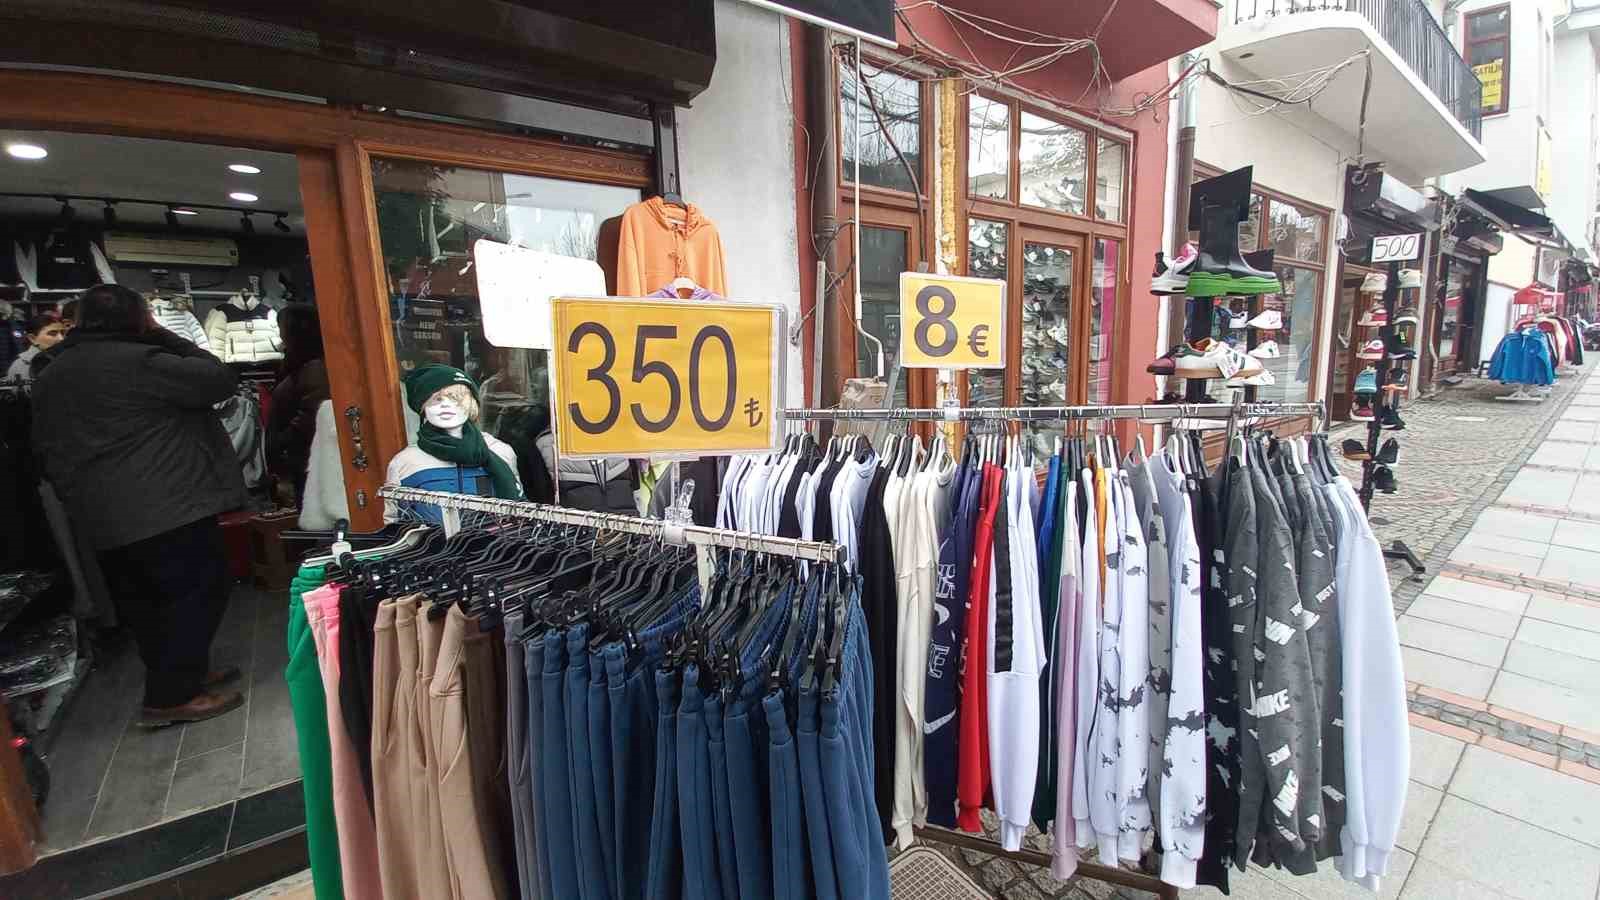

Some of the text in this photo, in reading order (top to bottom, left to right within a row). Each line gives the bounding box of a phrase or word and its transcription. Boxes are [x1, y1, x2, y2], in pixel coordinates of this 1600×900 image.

[1375, 236, 1416, 259] 500
[914, 285, 989, 357] 8 €
[568, 321, 737, 434] 350
